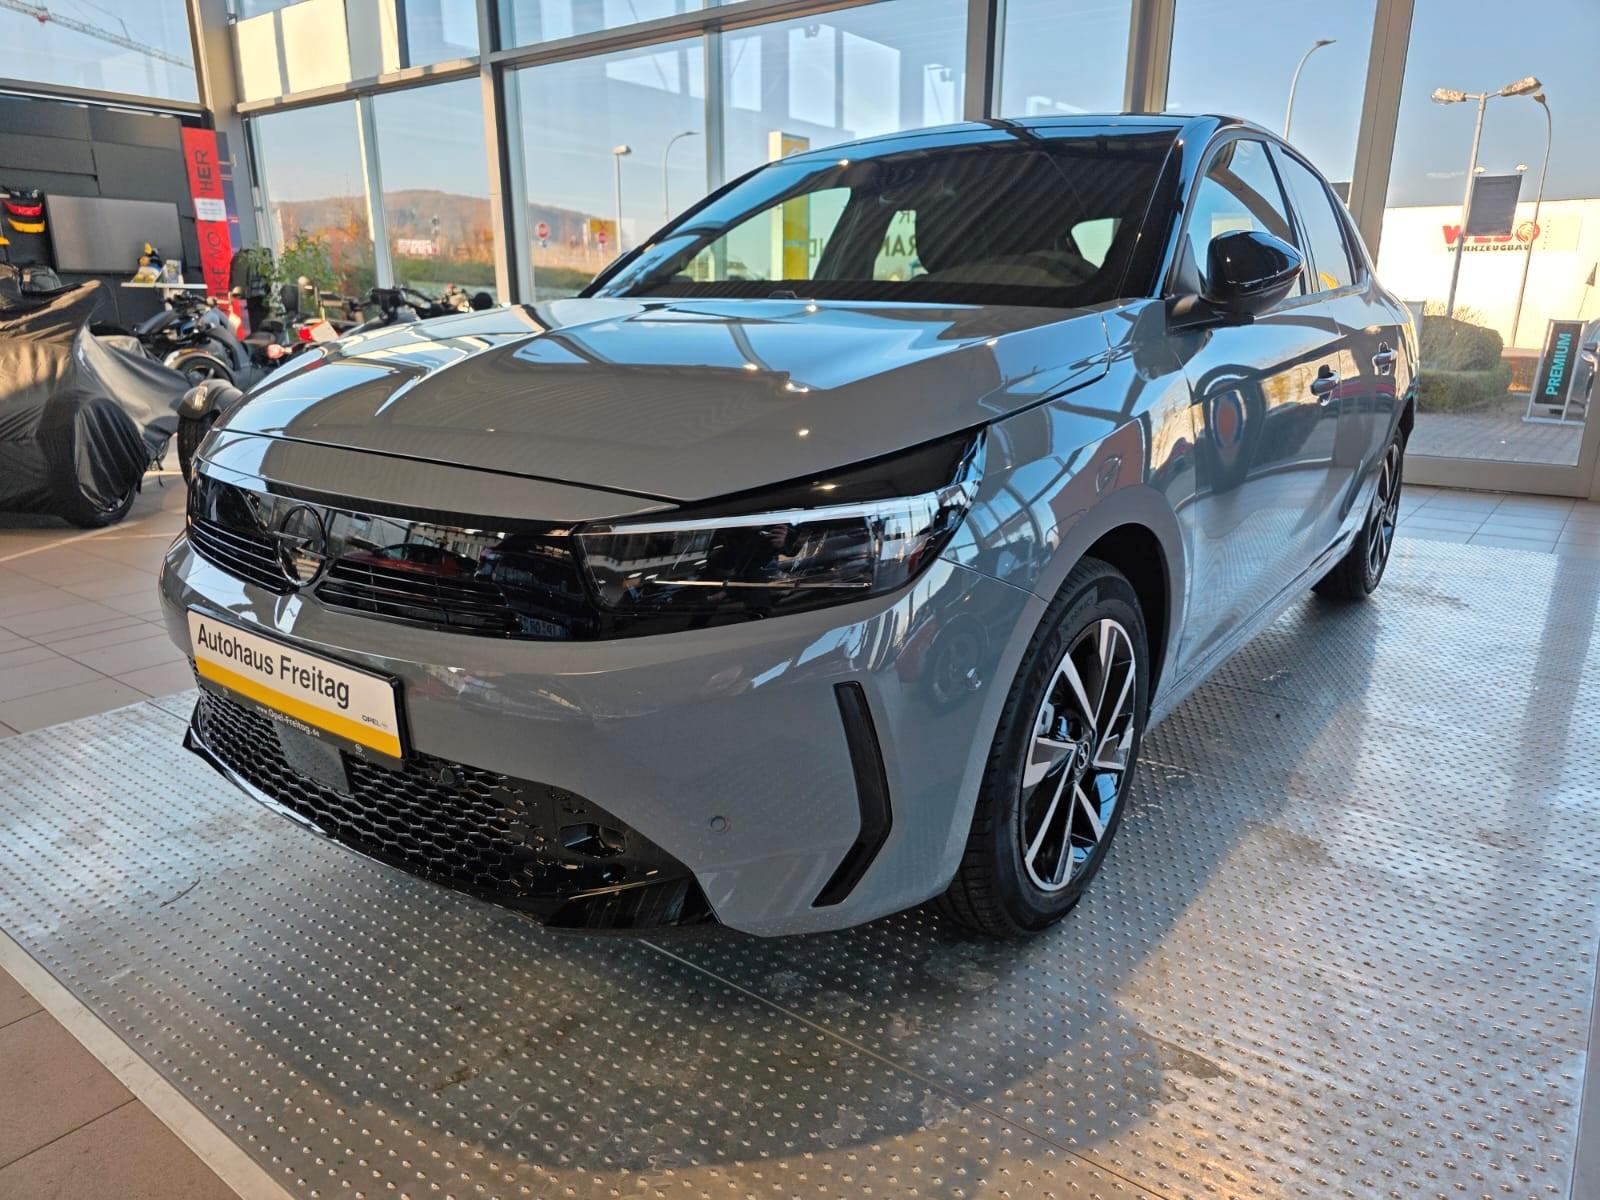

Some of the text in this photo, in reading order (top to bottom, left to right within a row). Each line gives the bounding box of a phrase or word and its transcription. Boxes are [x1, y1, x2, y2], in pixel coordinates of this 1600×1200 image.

[1545, 332, 1572, 396] PREMIUM
[197, 623, 349, 710] Autohaus Freitag
